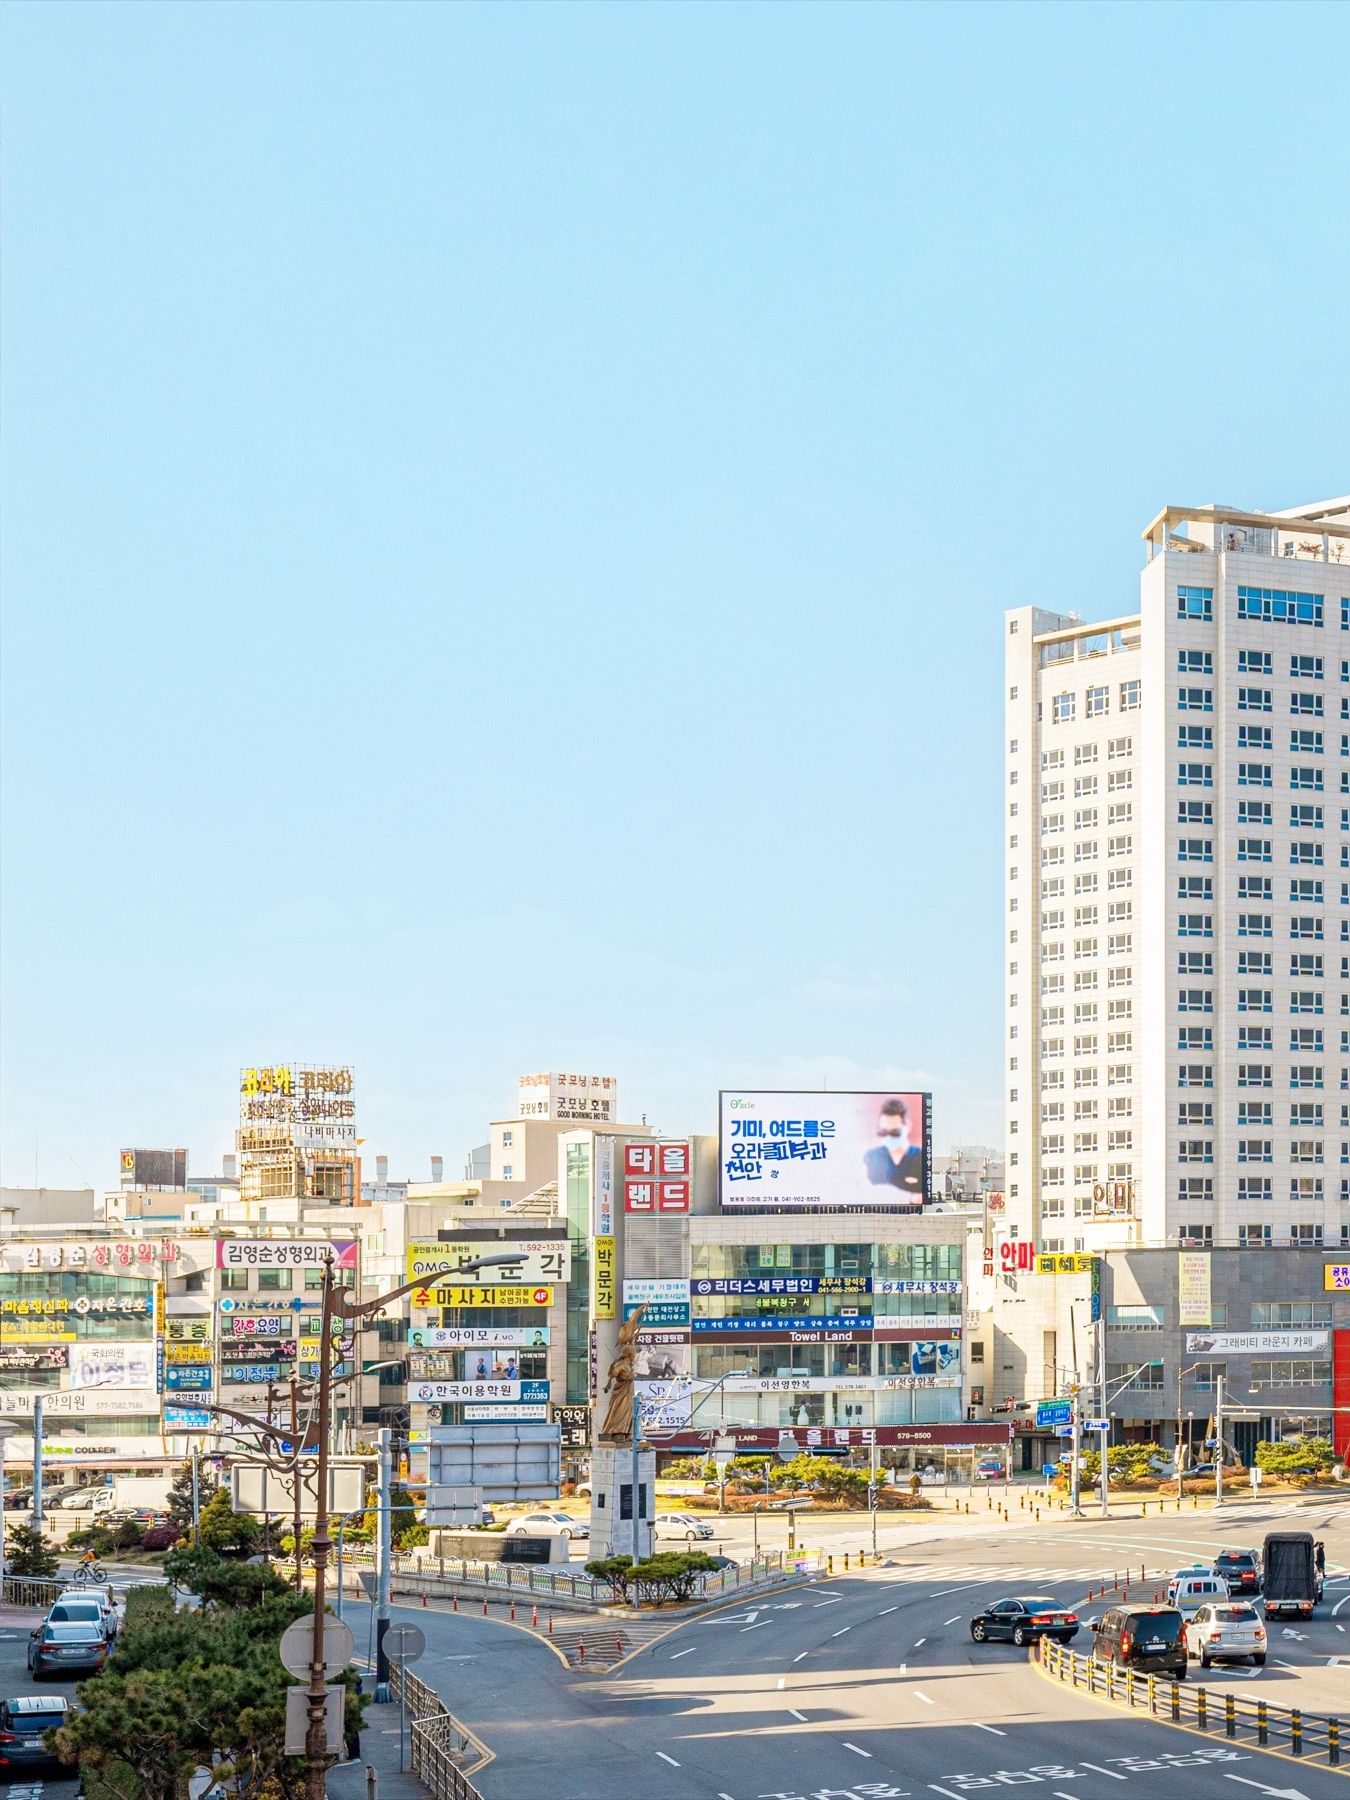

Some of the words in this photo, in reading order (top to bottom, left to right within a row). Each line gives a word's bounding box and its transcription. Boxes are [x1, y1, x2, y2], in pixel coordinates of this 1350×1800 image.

[244, 1067, 292, 1096] 코리아
[299, 1070, 352, 1093] 코리아
[557, 1110, 570, 1118] GOOD
[572, 1111, 593, 1120] MORNING
[594, 1113, 609, 1121] HOTEL
[305, 1126, 356, 1141] 나비마사지
[731, 1120, 766, 1139] 기미,
[769, 1120, 836, 1138] 여드름은
[629, 1148, 687, 1173] 타올
[725, 1160, 762, 1182] 천안
[629, 1184, 687, 1210] 랜드
[92, 1243, 178, 1266] 성형외과
[229, 1245, 333, 1263] 김영순성형외과
[519, 1244, 566, 1252] T.592-1335
[1001, 1242, 1035, 1273] 안마
[597, 1249, 613, 1310] 박문각
[715, 1280, 813, 1294] 리더스세무법인
[818, 1278, 842, 1287] 세무사
[843, 1277, 867, 1287] 장석강
[895, 1281, 925, 1293] 세무사
[928, 1281, 957, 1294] 장석강
[534, 1292, 547, 1302] 4F
[0, 1299, 69, 1315] 마음정신과
[168, 1323, 208, 1339] 통증
[234, 1318, 280, 1335] 간호요양
[449, 1330, 489, 1342] 아이모
[789, 1332, 821, 1342] Towel
[824, 1331, 854, 1342] Land
[1219, 1336, 1259, 1350] 그래비티
[1262, 1335, 1290, 1348] 라운지
[1293, 1335, 1314, 1346] 카페
[91, 1348, 124, 1358] 국회의원
[436, 1385, 512, 1398] 한국이용학원
[760, 1380, 811, 1391] 이선영한복
[888, 1378, 937, 1390] 이선영한복
[47, 1395, 86, 1411] 한의원
[554, 1410, 586, 1424] 홀인원
[896, 1432, 932, 1440] 579-8500
